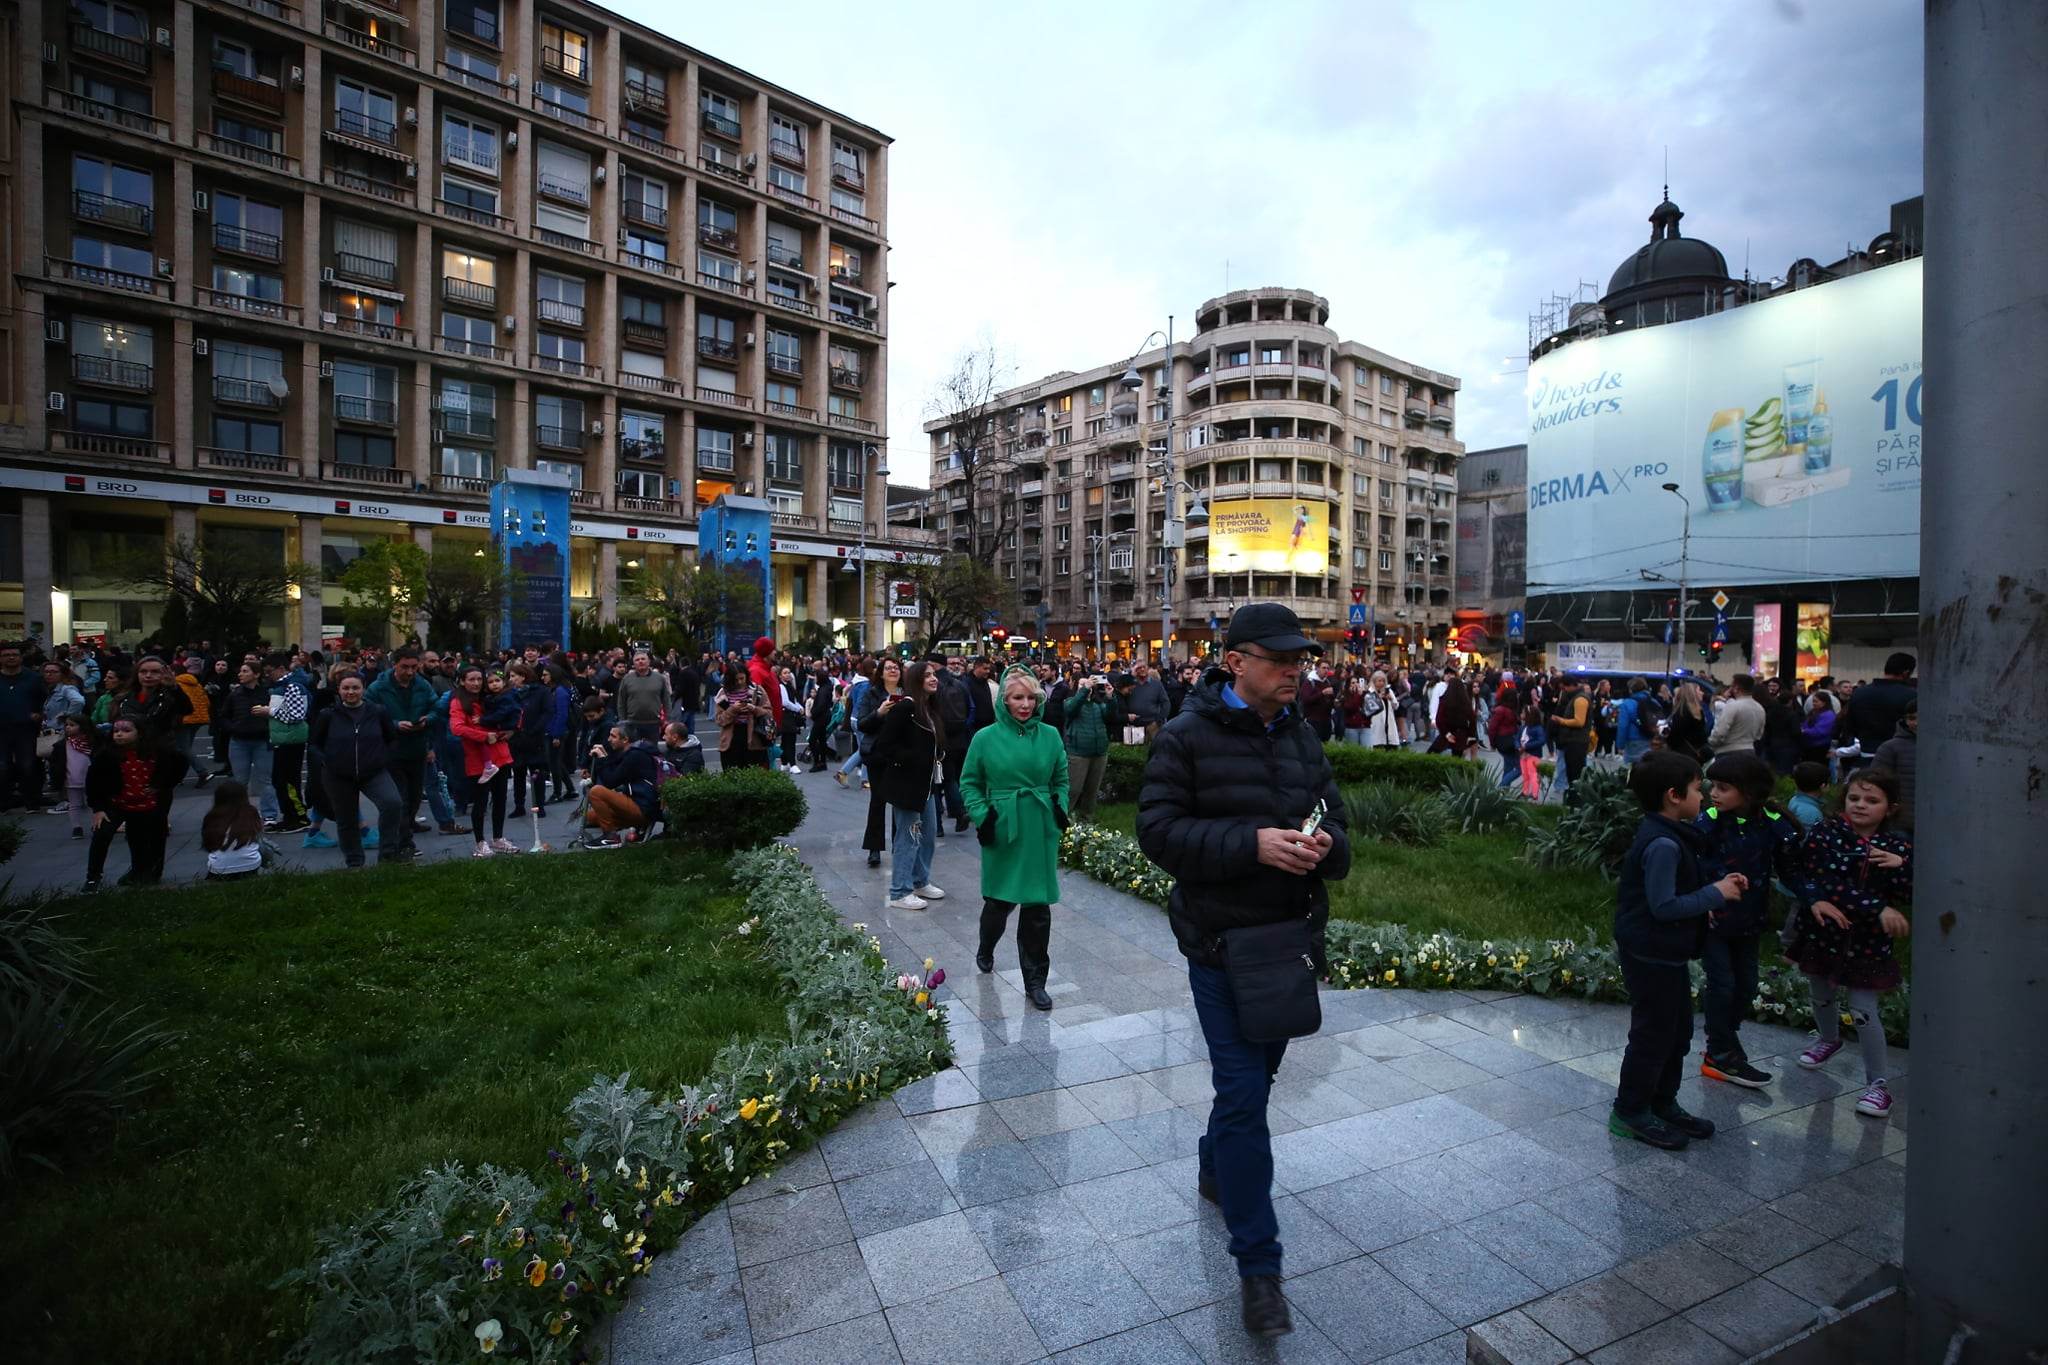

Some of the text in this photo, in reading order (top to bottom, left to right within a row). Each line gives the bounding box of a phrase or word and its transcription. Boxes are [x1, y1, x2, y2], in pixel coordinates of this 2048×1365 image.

[1549, 370, 1623, 406] head &
[1532, 396, 1622, 436] shoulders
[97, 482, 137, 492] BRD
[235, 494, 271, 504] BRD
[358, 505, 389, 515] BRD
[643, 531, 666, 539] BRD
[781, 542, 800, 551] BRD
[895, 607, 917, 616] BRD
